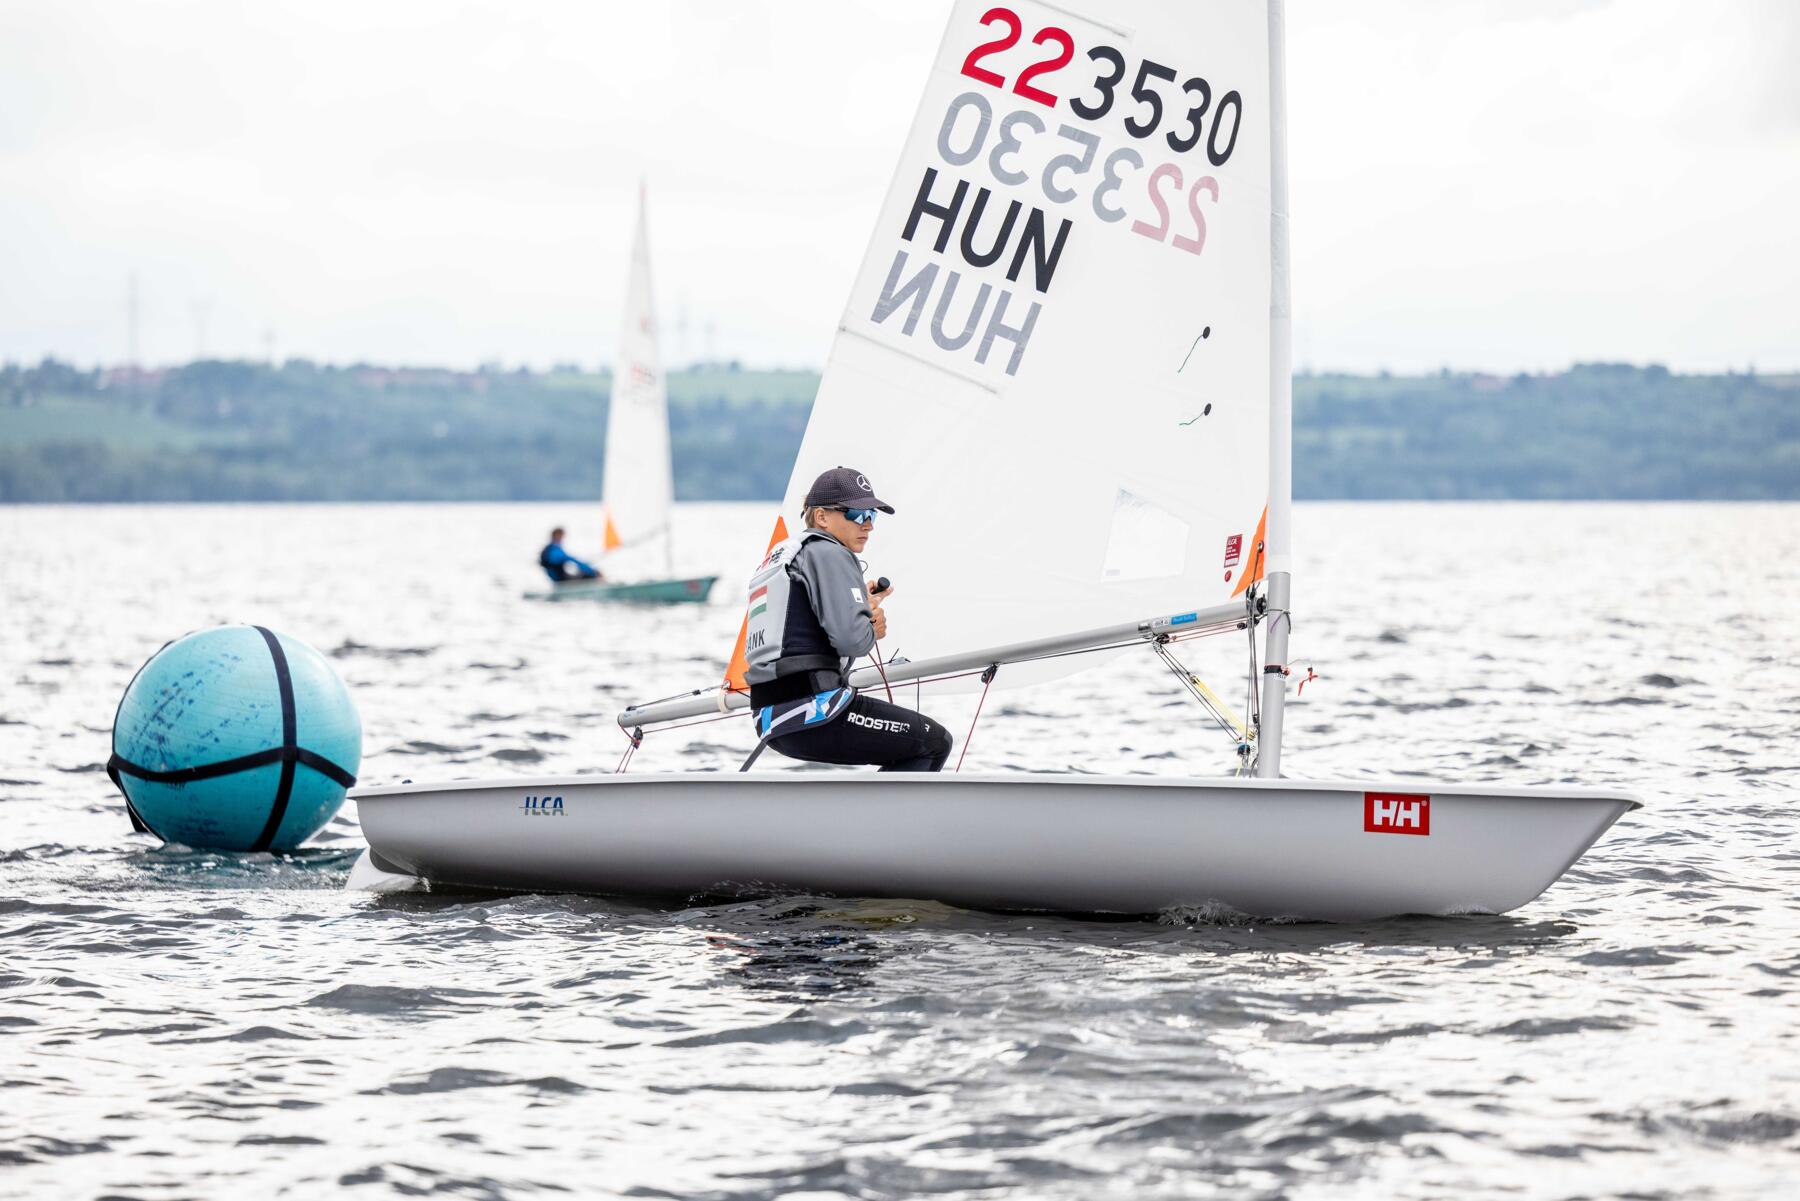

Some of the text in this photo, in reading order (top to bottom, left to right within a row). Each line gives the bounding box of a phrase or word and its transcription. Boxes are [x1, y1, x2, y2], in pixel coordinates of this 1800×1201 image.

[960, 7, 1242, 167] 223530
[901, 167, 1073, 293] HUN
[524, 796, 565, 816] ILCA
